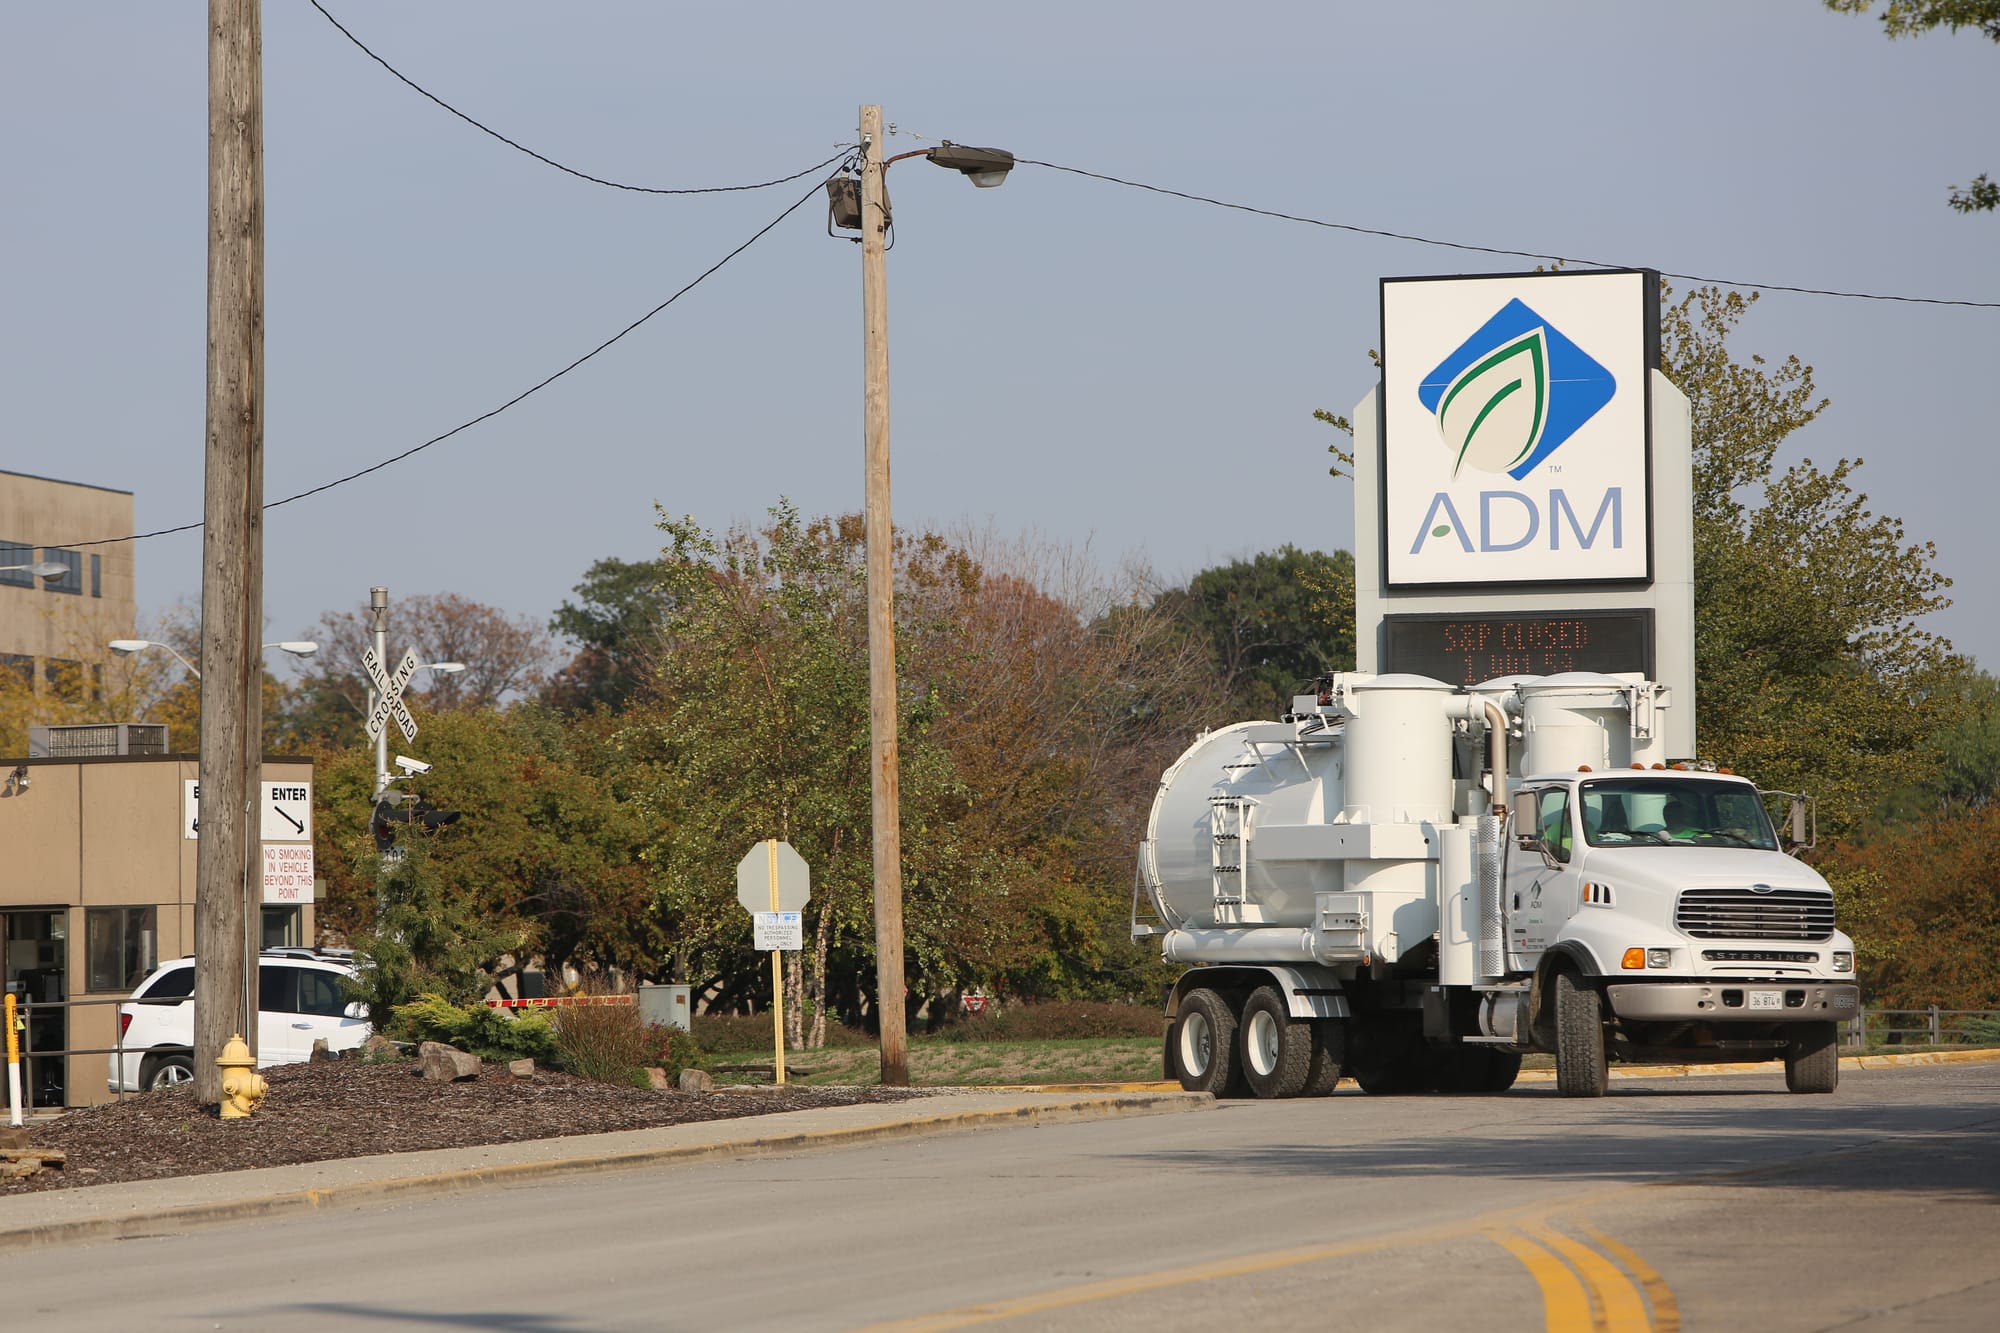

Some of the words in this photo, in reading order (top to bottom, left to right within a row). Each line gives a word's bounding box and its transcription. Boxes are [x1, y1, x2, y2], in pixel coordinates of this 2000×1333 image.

[1549, 465, 1562, 473] TM
[1409, 487, 1623, 554] ADM
[1443, 623, 1491, 651] S&P
[1502, 620, 1588, 651] CLOSED
[364, 651, 385, 689] RAIL
[393, 701, 415, 738] ROAD
[370, 656, 414, 734] CROSSING
[272, 787, 306, 801] ENTER
[265, 849, 275, 859] NO
[279, 849, 312, 860] SMOKING
[268, 862, 276, 872] IN
[279, 862, 308, 873] VEHICLE
[264, 875, 294, 886] BEYOND
[297, 875, 313, 886] THIS
[278, 888, 299, 899] POINT
[1716, 952, 1806, 960] STERLING
